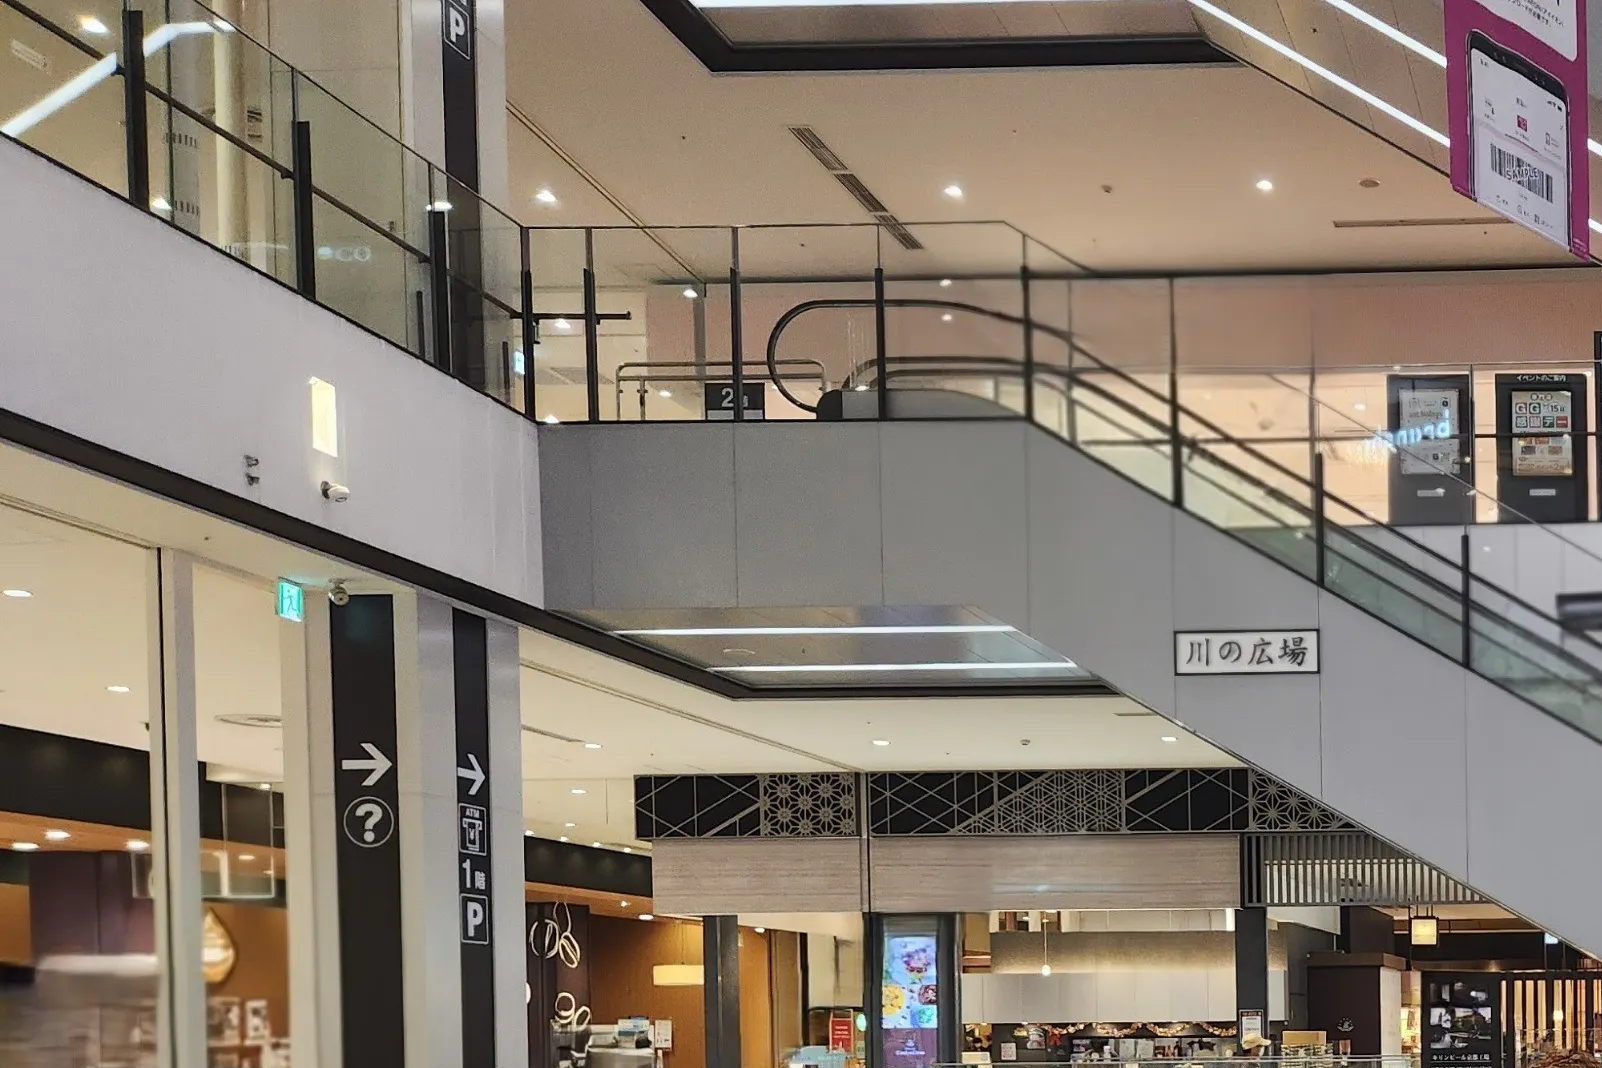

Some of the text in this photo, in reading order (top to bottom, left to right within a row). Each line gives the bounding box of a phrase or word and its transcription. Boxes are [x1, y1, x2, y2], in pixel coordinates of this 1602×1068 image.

[450, 7, 465, 43] P
[1506, 167, 1538, 181] SAMPLE
[1186, 636, 1309, 667] 川の広場
[465, 808, 480, 819] ATM
[462, 859, 486, 890] 1階
[467, 901, 484, 937] P
